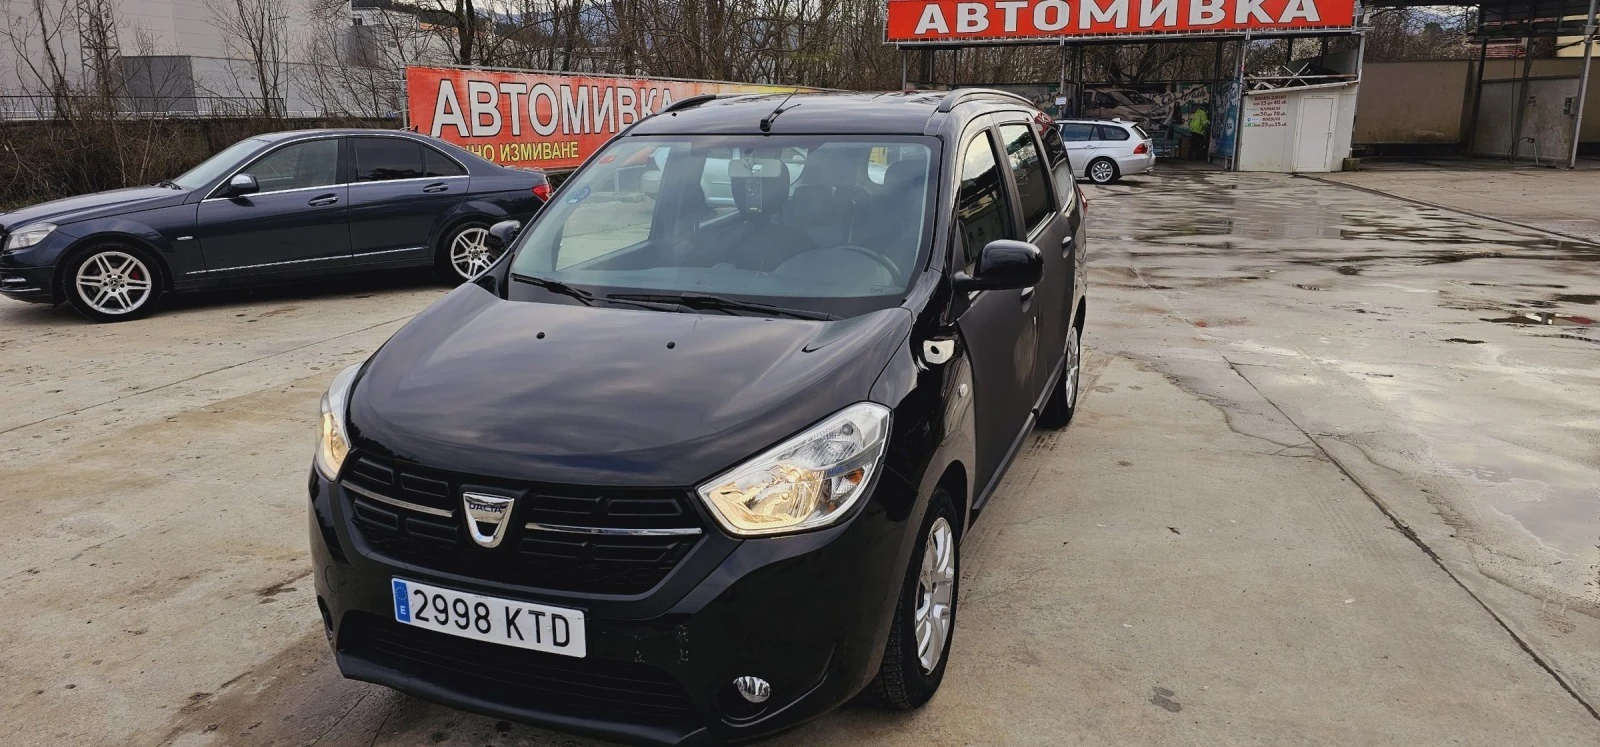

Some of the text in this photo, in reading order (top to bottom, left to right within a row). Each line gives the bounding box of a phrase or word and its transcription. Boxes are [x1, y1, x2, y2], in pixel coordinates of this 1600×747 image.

[914, 0, 1321, 35] АВТОМИВКА
[500, 141, 579, 162] ИЗМИВАНЕ
[469, 503, 502, 514] DACIA
[400, 606, 406, 615] E
[413, 589, 570, 648] 2998 KTD
